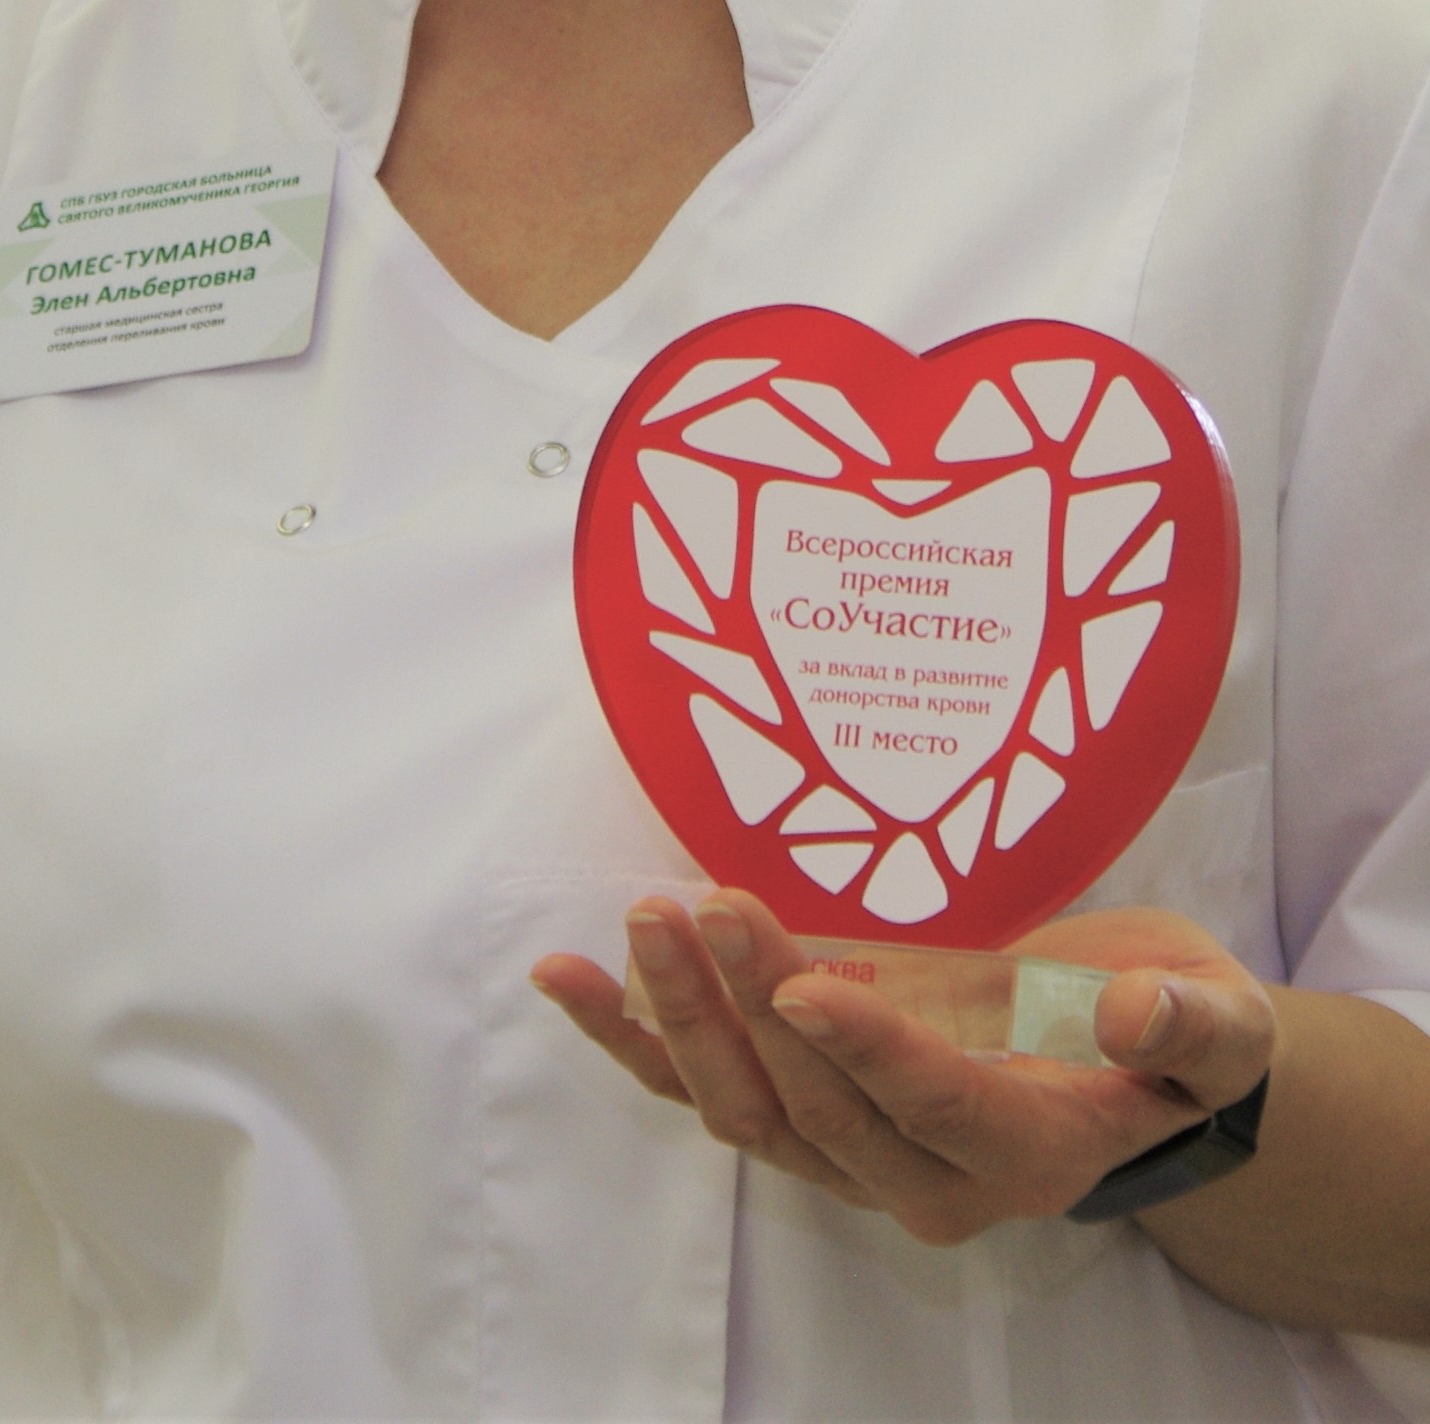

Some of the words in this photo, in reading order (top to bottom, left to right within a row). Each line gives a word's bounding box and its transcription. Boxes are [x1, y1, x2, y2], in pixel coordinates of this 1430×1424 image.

[57, 206, 114, 225] СВЯТОГО
[117, 187, 241, 216] ВЕЛИКОМУЧЕНИКА
[243, 176, 300, 196] ГЕОРГИЯ
[59, 194, 85, 210] СПБ
[88, 189, 118, 205] ГБУЗ
[121, 178, 197, 199] ГОРОДСКАЯ
[200, 166, 272, 187] БОЛЬНИЦА
[26, 229, 272, 285] ГОМЕС-ТУМАНОВА
[30, 289, 89, 316] Элен
[96, 266, 256, 305] Альбертовна
[46, 334, 108, 353] отделения
[110, 324, 188, 343] переливания
[189, 318, 226, 333] крови
[53, 321, 102, 337] старшая
[105, 309, 183, 328] медицинская
[185, 302, 224, 318] сестра
[785, 529, 1014, 569] Всероссийская
[840, 571, 950, 597] премия
[770, 597, 1012, 643] «СоУчастие»
[798, 659, 821, 675] за
[827, 661, 887, 682] вклад
[894, 667, 907, 681] в
[912, 667, 1009, 689] развитие
[808, 687, 920, 710] донорства
[926, 696, 992, 716] крови
[833, 723, 862, 748] III
[872, 731, 958, 756] место
